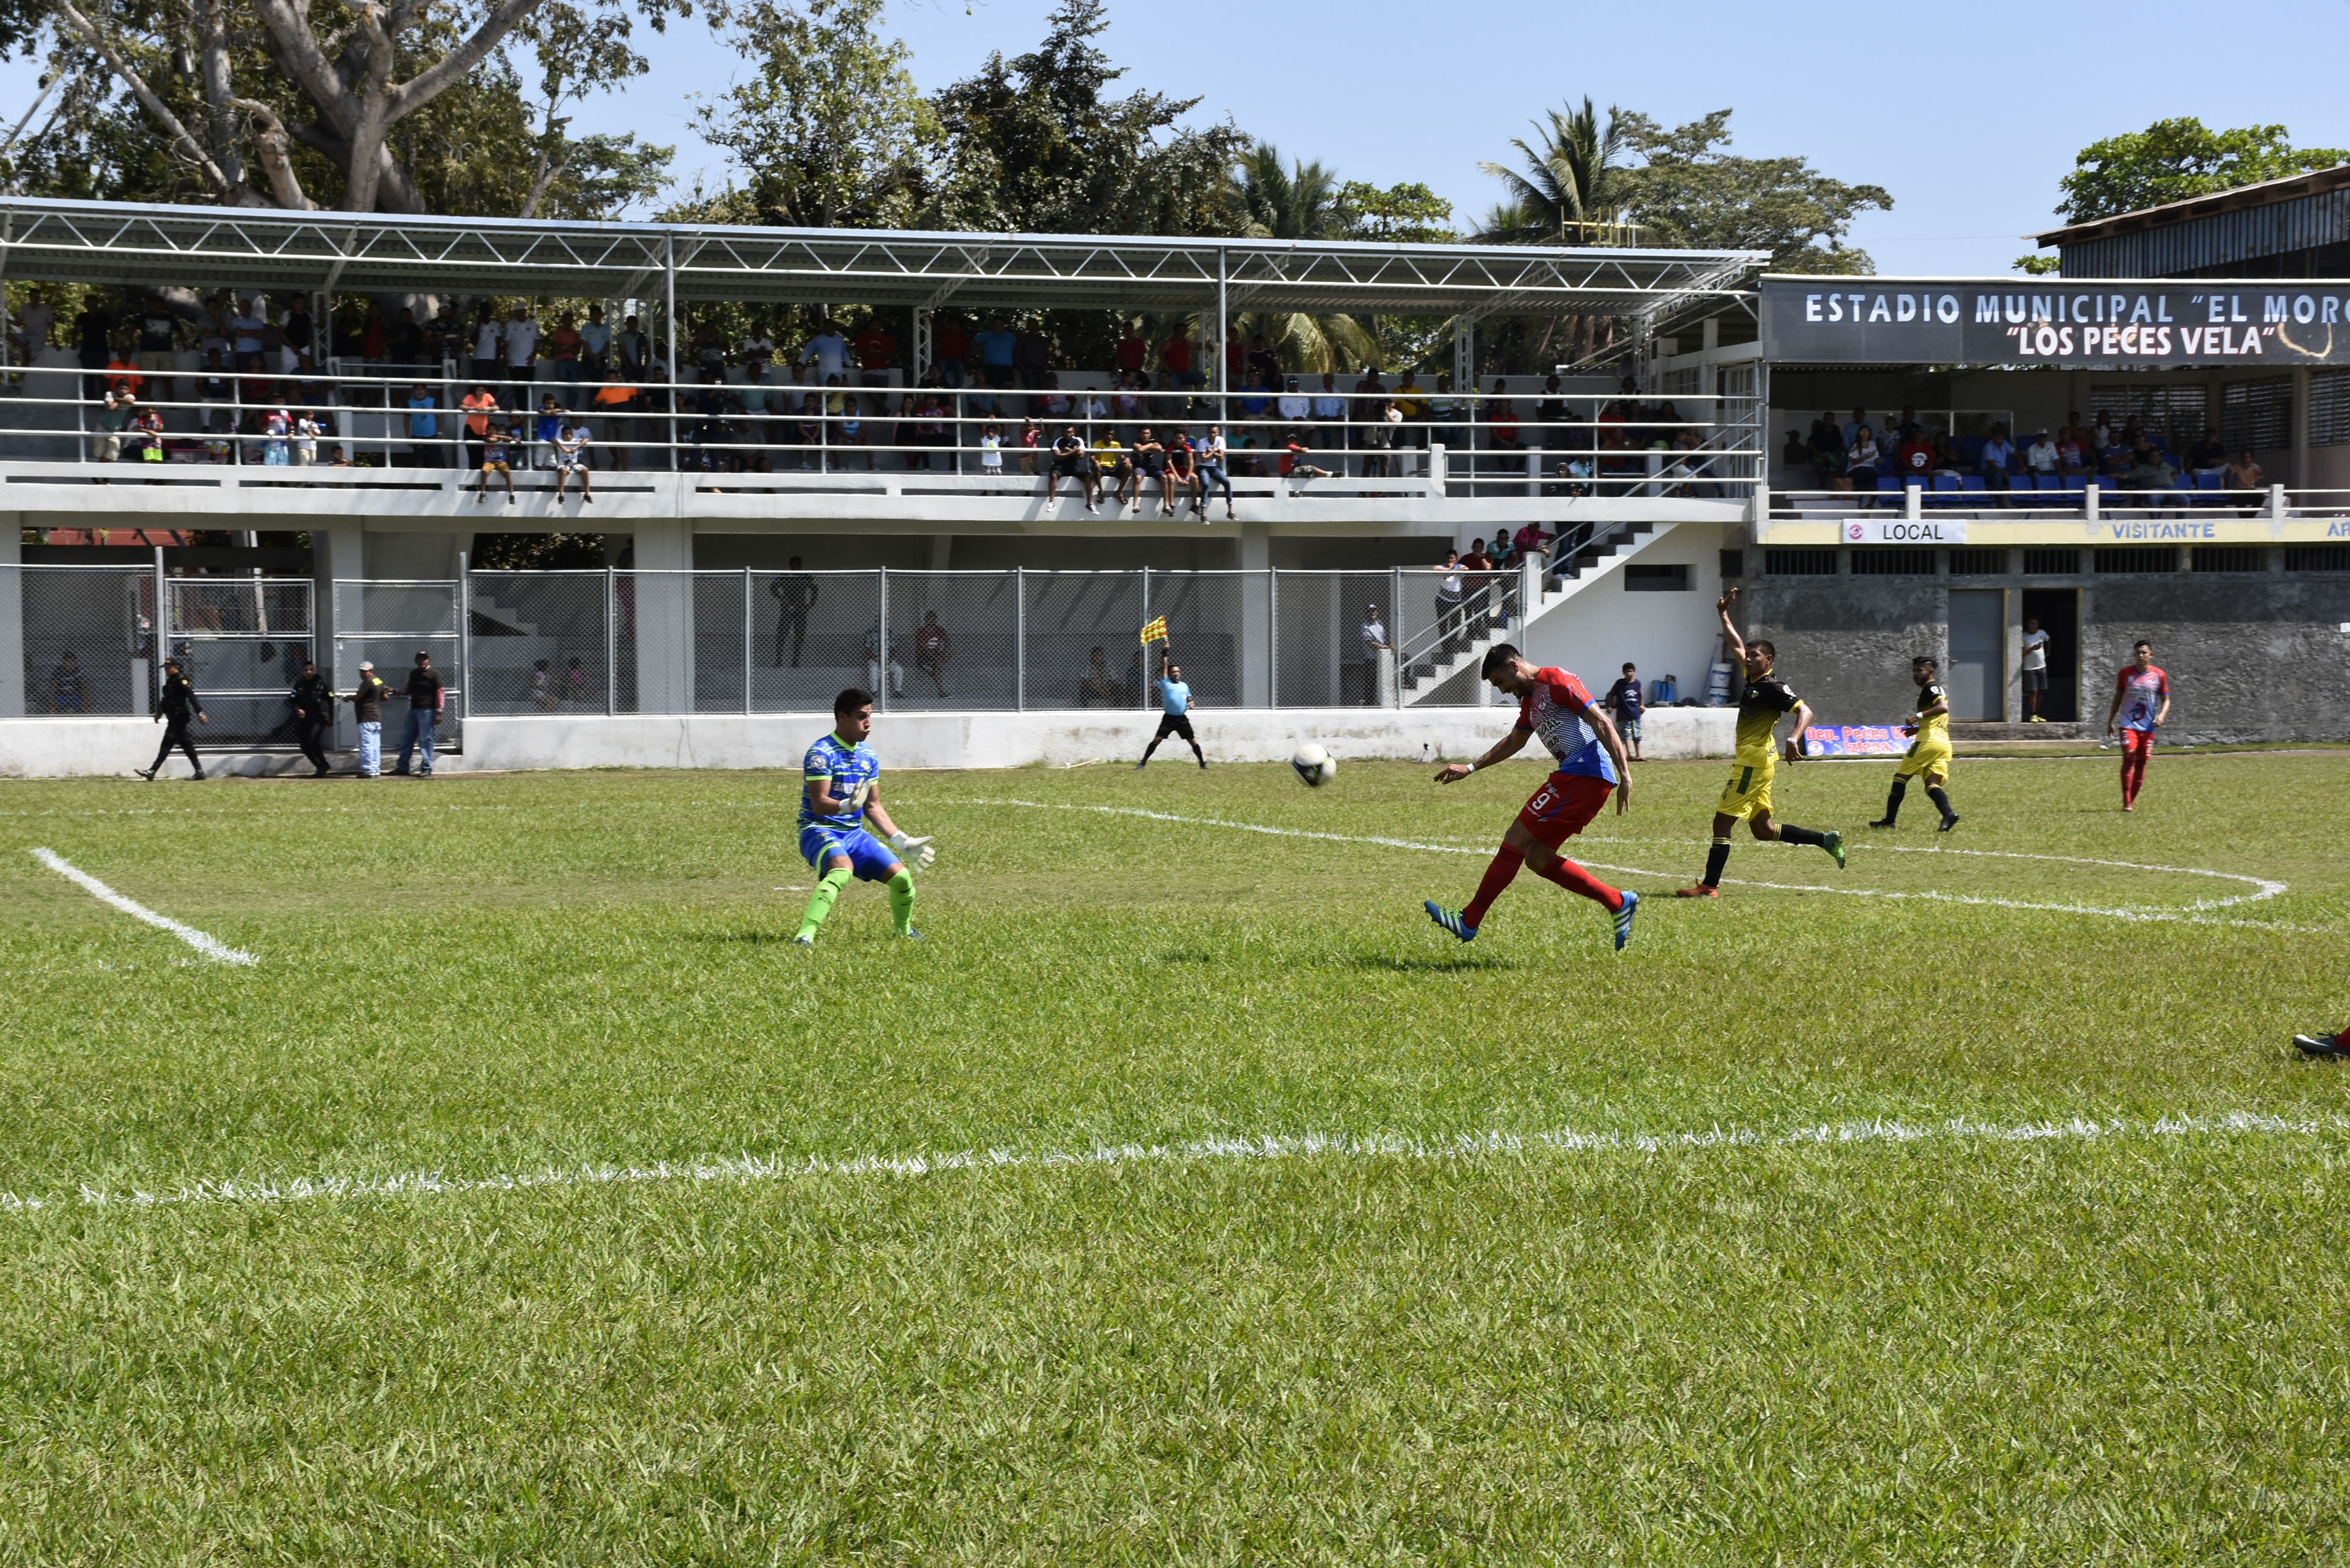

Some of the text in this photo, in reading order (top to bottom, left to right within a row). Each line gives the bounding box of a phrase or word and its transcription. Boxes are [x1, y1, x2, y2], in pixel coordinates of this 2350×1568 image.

[1806, 293, 1959, 323] ESTADIO
[1975, 294, 2174, 323] MUNICIPAL
[2263, 294, 2350, 324] MOR
[2084, 326, 2172, 355] PECES
[1883, 524, 1944, 540] LOCAL
[2112, 523, 2216, 539] VISITANTE
[1806, 727, 1840, 741] Dep.
[1841, 727, 1889, 740] Peces
[1531, 792, 1550, 810] 9
